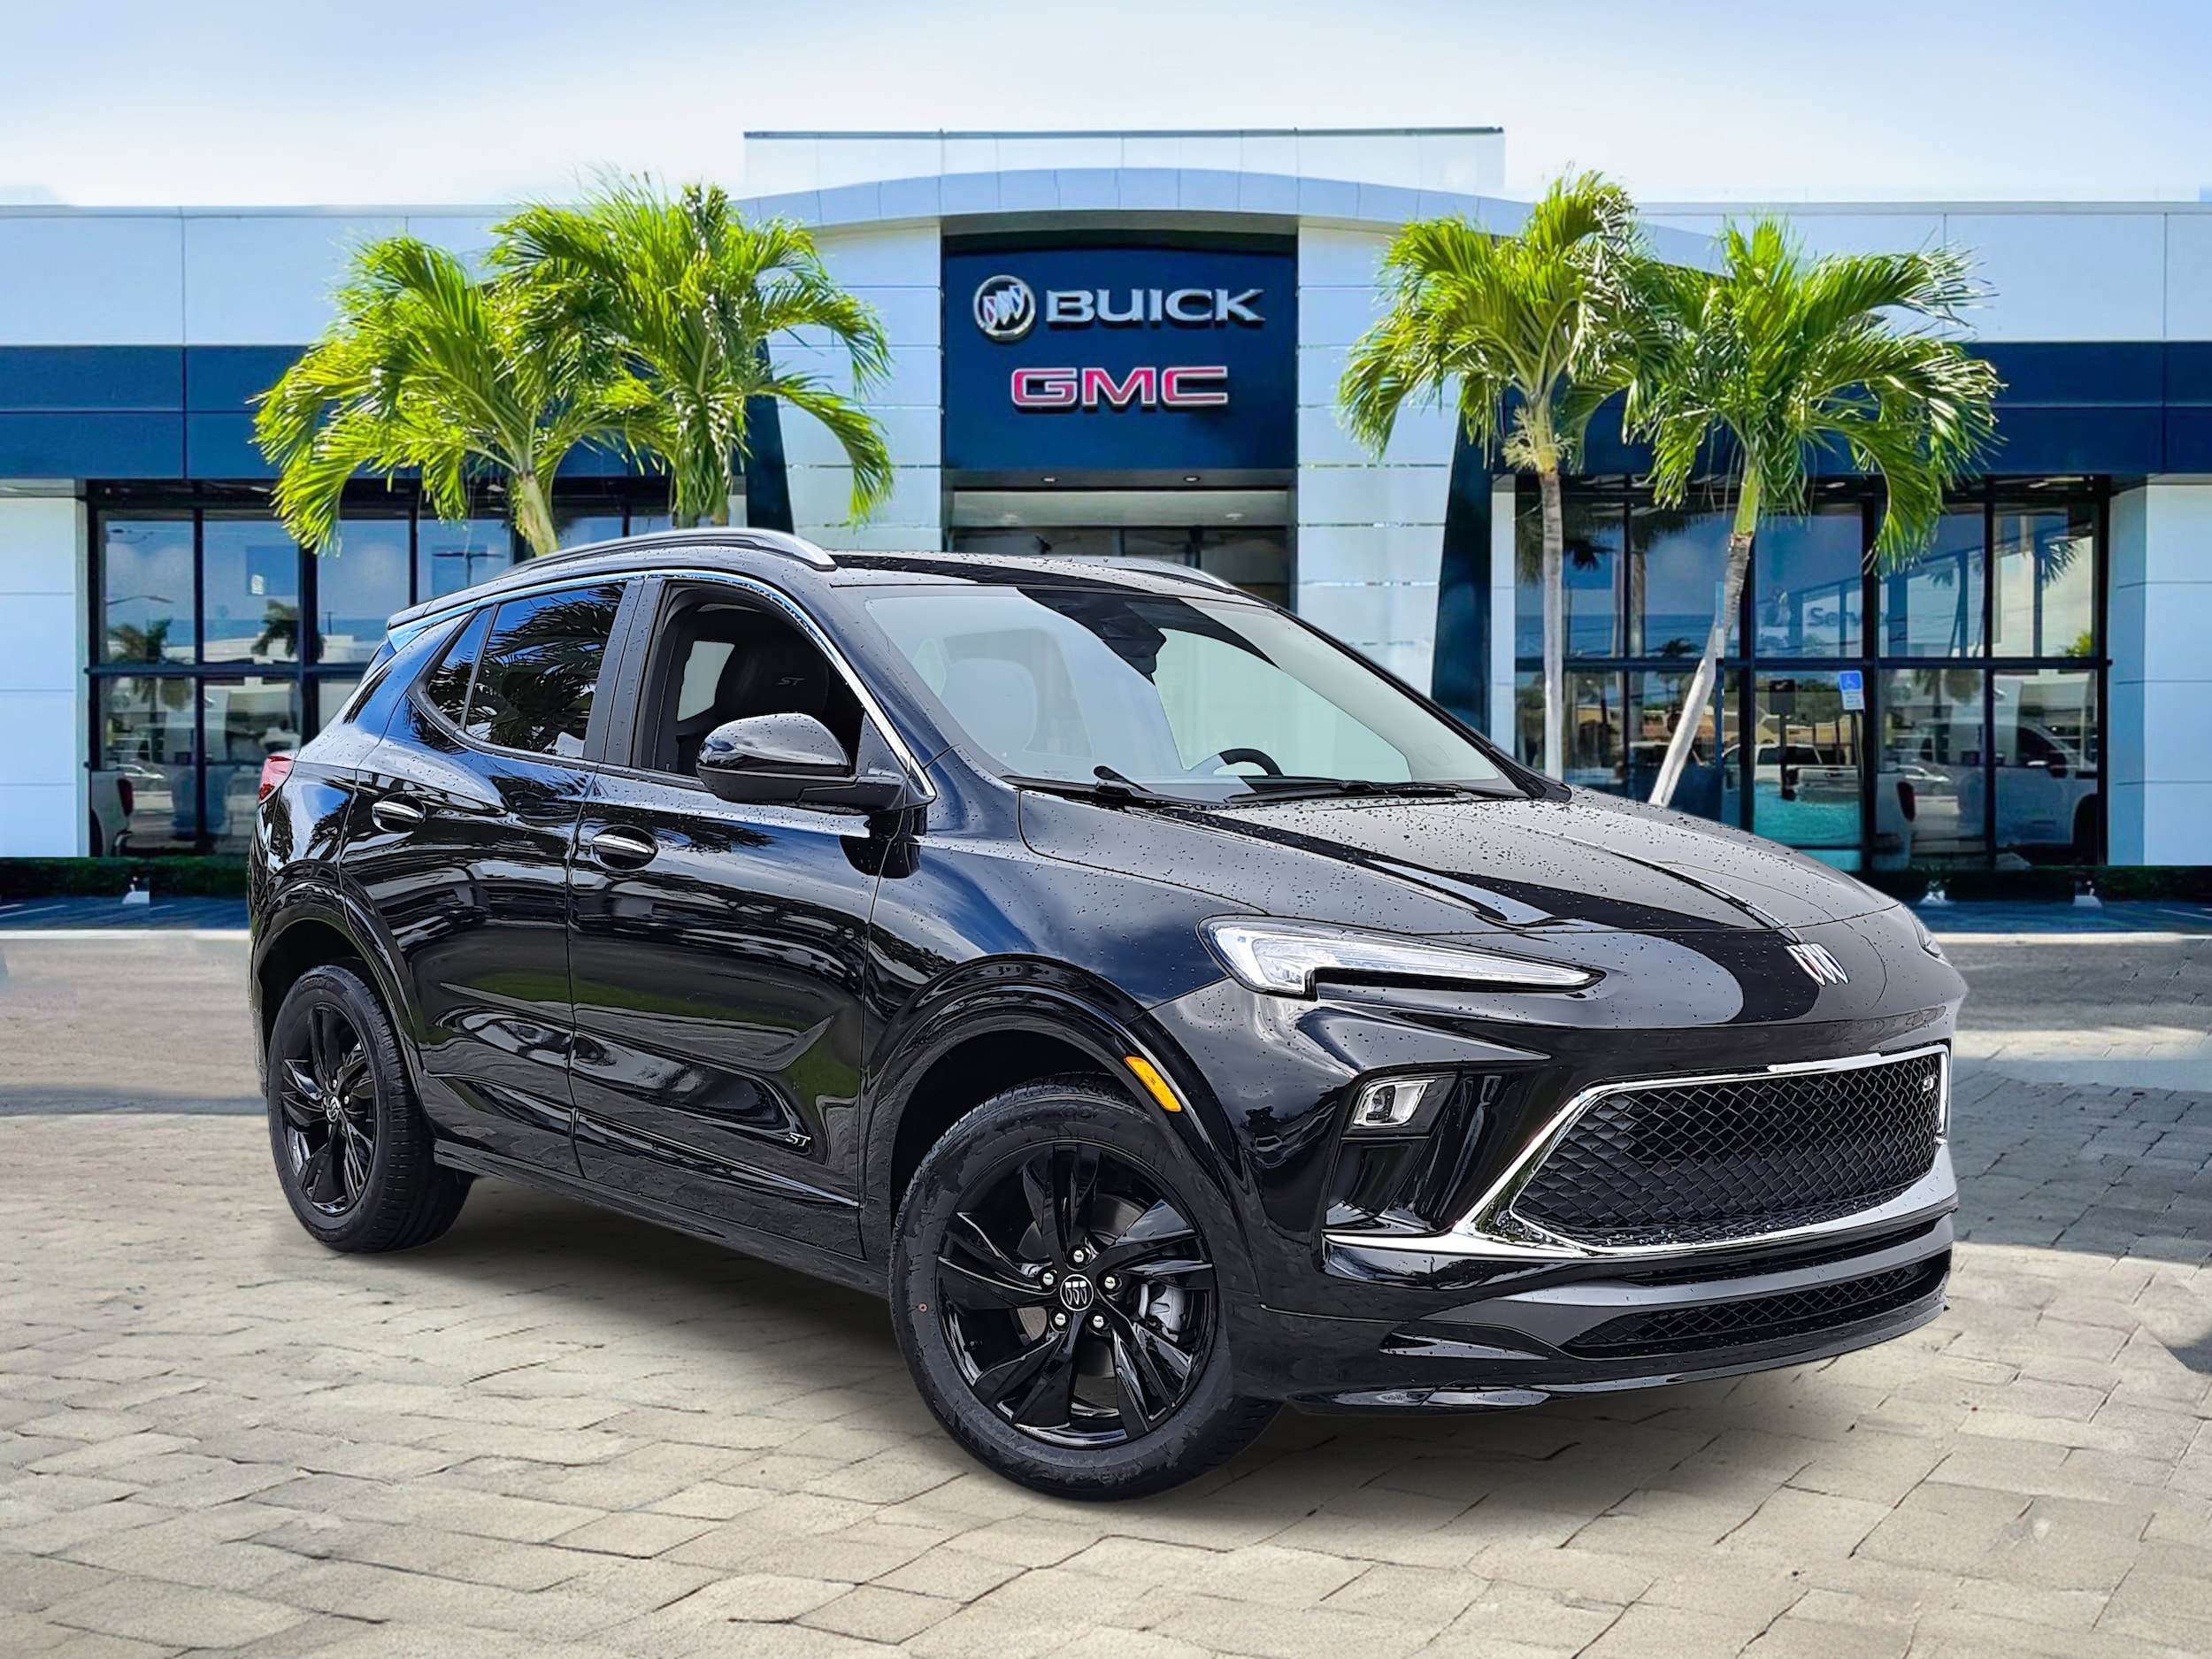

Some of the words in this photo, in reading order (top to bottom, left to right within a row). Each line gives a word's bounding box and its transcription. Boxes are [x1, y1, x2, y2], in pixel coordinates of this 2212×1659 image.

[1046, 288, 1265, 322] BUICK
[1011, 365, 1228, 407] GMC
[777, 676, 805, 686] ST
[785, 1132, 811, 1147] ST
